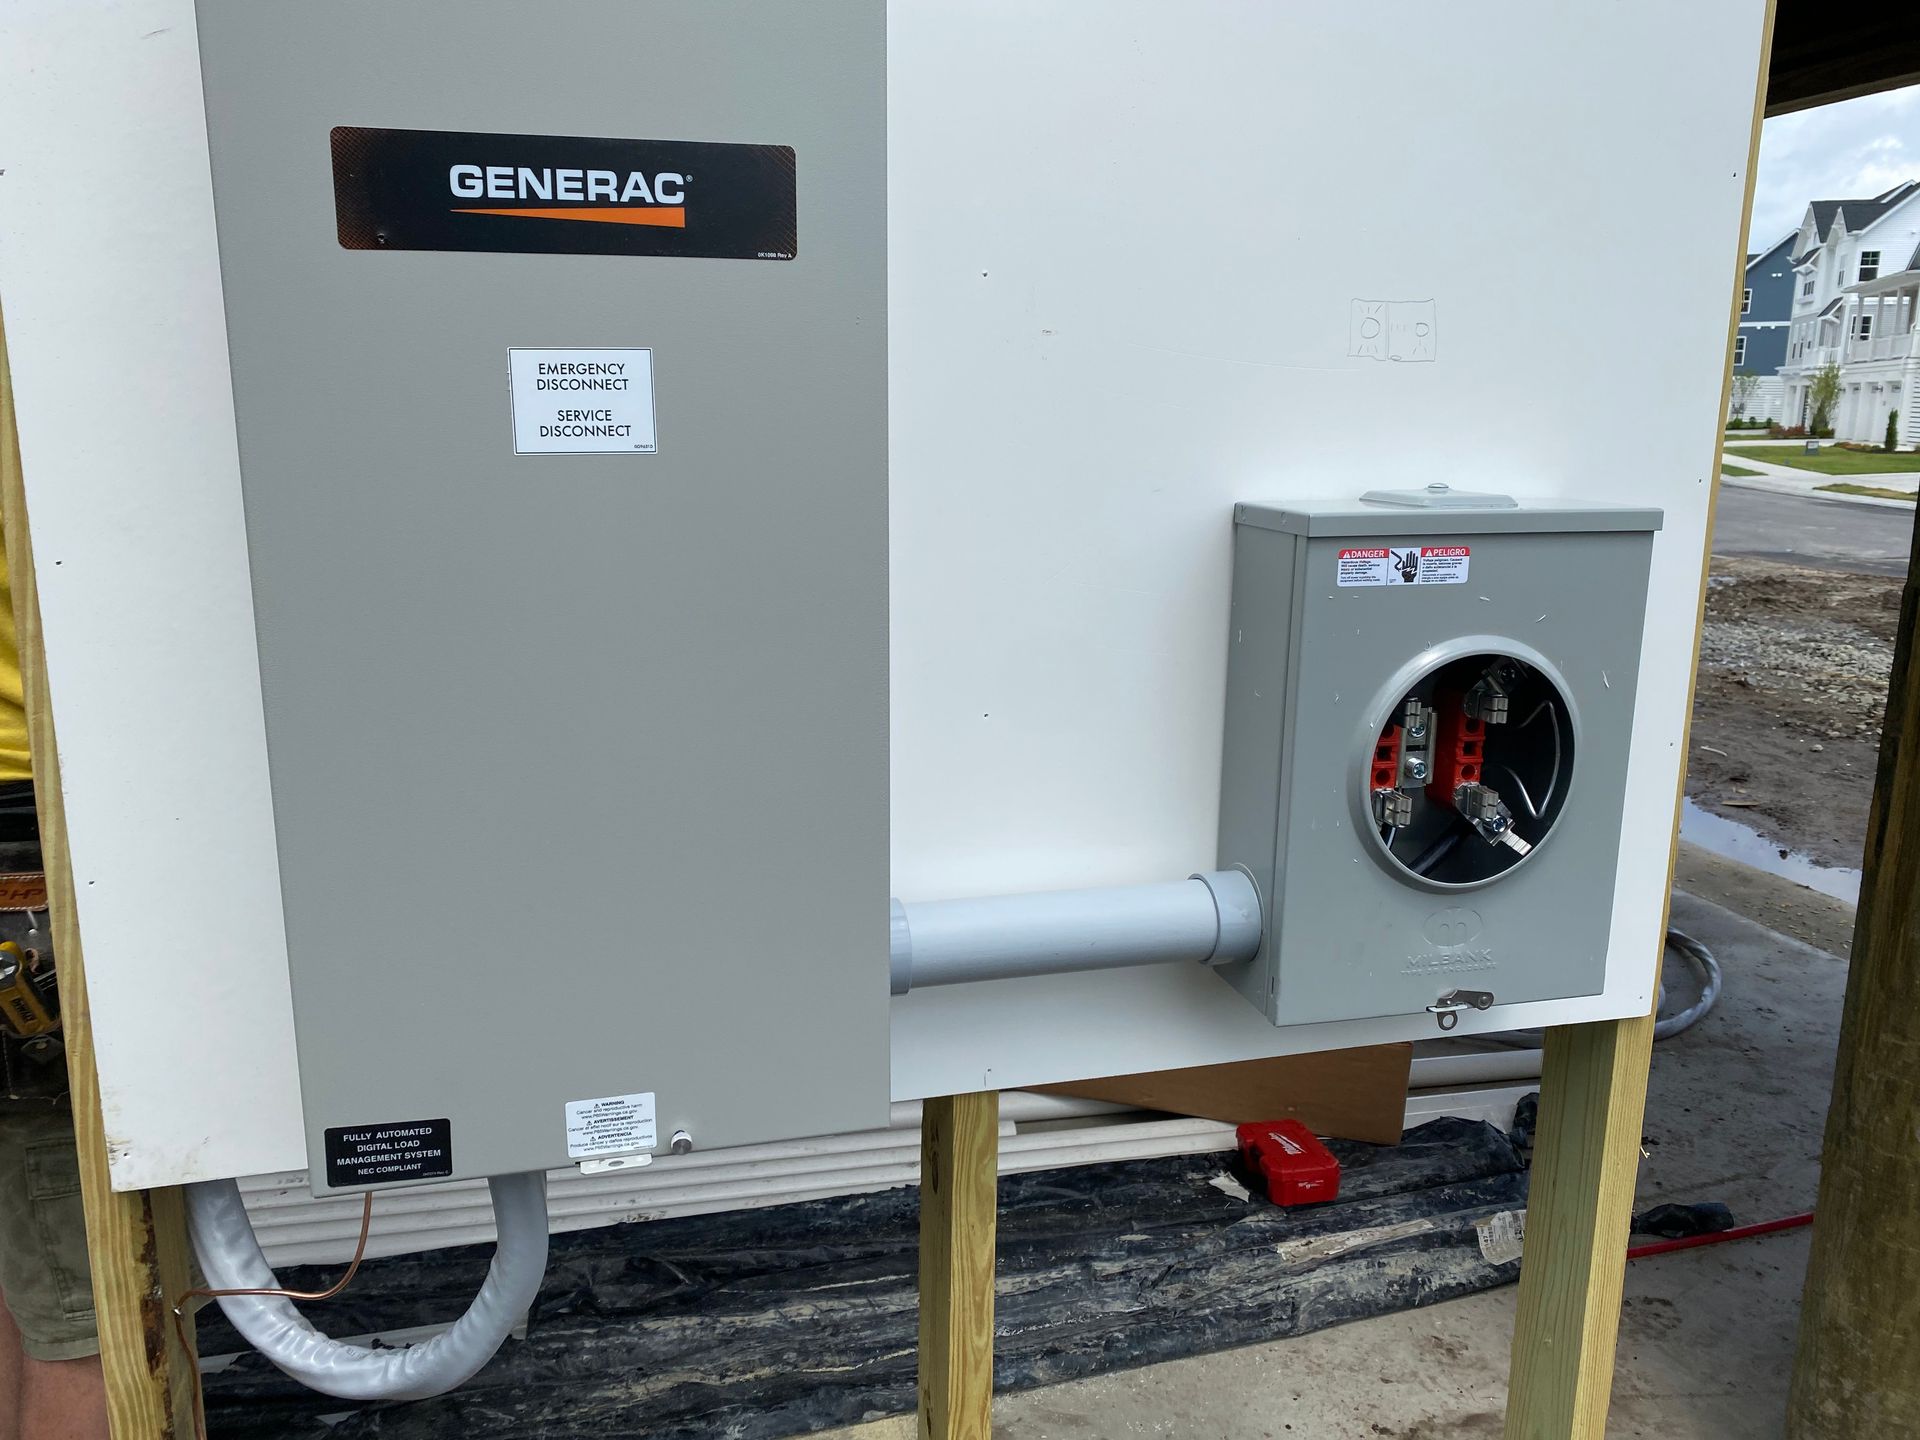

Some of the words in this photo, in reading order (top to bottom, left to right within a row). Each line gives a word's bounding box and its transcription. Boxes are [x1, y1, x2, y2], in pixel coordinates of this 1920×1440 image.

[449, 164, 685, 205] GENERAC
[538, 363, 625, 375] EMERGENCY
[537, 379, 629, 391] DISCONNECT
[557, 410, 612, 422] SERVICE
[540, 425, 631, 437] DISCONNECT
[1351, 550, 1385, 558] DANGER
[1433, 548, 1466, 556] PELIGRO
[594, 1115, 634, 1124] AVERTISSEMENT
[343, 1133, 372, 1142] FULLY
[376, 1127, 432, 1139] AUTOMATED
[598, 1131, 632, 1140] ADVERTENCIA
[357, 1143, 393, 1152] DIGITAL
[395, 1140, 420, 1149] LOAD
[337, 1153, 403, 1166] MANAGEMENT
[404, 1149, 441, 1159] SYSTEM
[358, 1167, 375, 1175] NEC
[376, 1163, 422, 1173] COMPLIANT
